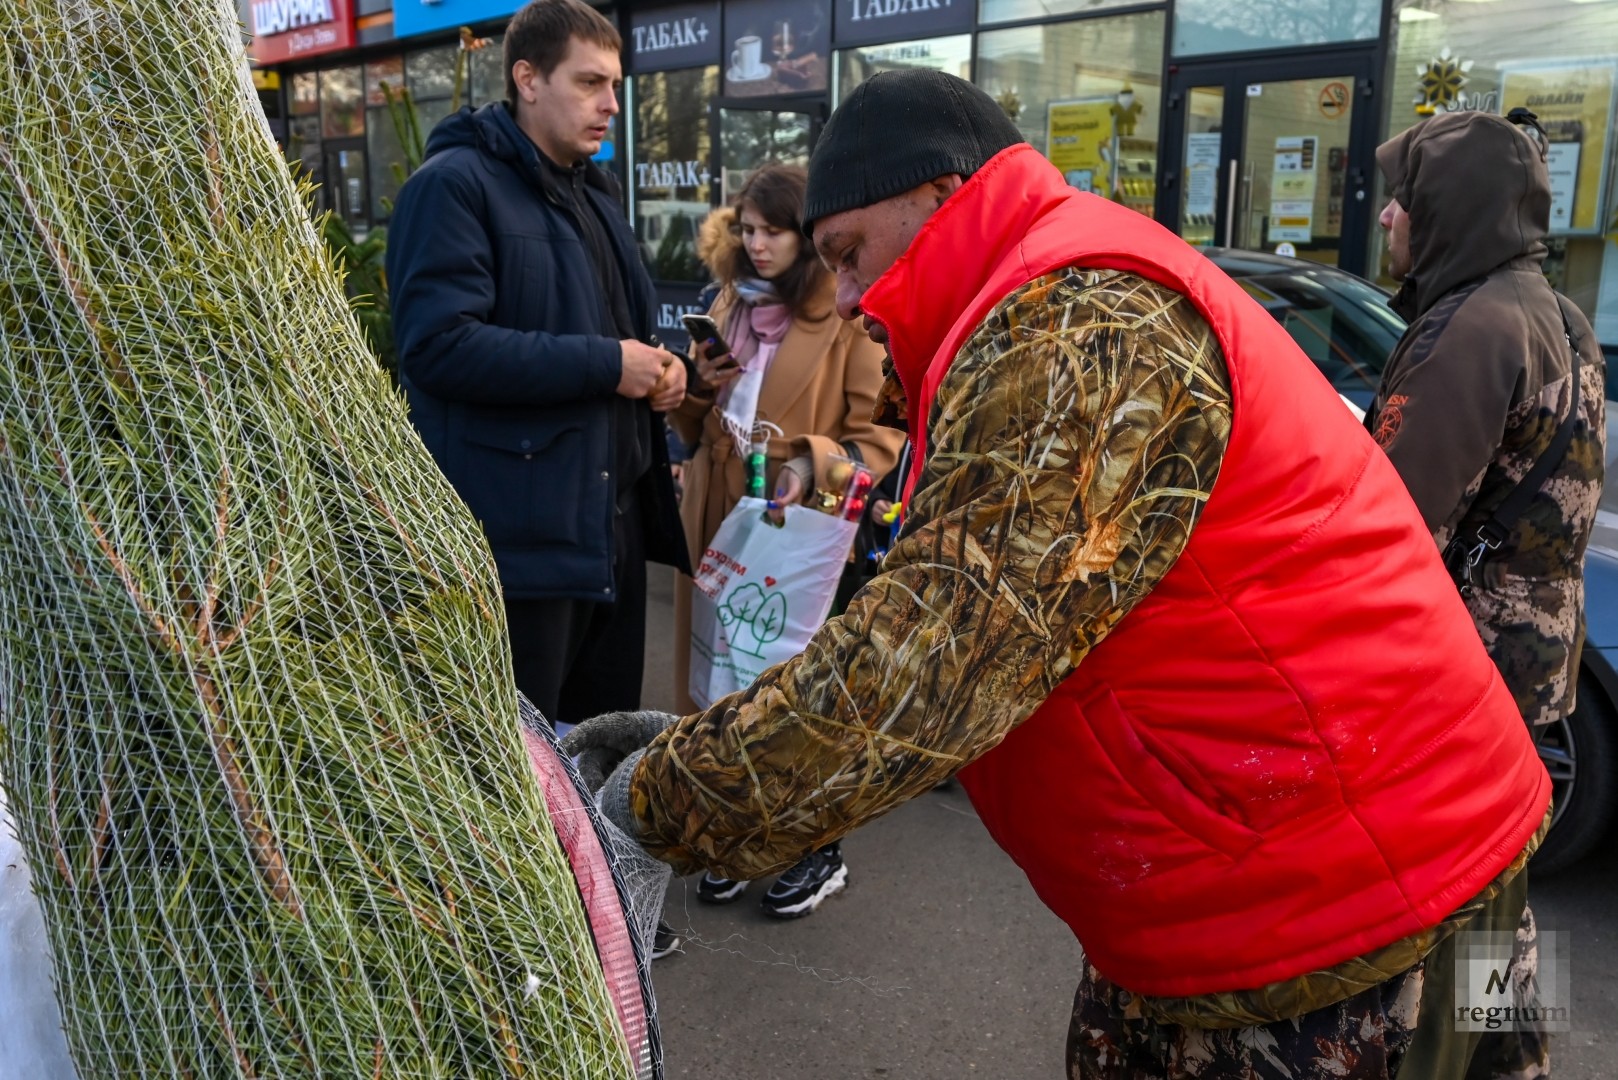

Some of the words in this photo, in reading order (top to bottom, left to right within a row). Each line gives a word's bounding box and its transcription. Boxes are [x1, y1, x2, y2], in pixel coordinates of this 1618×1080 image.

[253, 0, 335, 35] ШАУРМА
[632, 17, 709, 53] ТАБАК+
[1526, 91, 1584, 106] ОНЛАЙН
[636, 161, 711, 188] ТАБАК+
